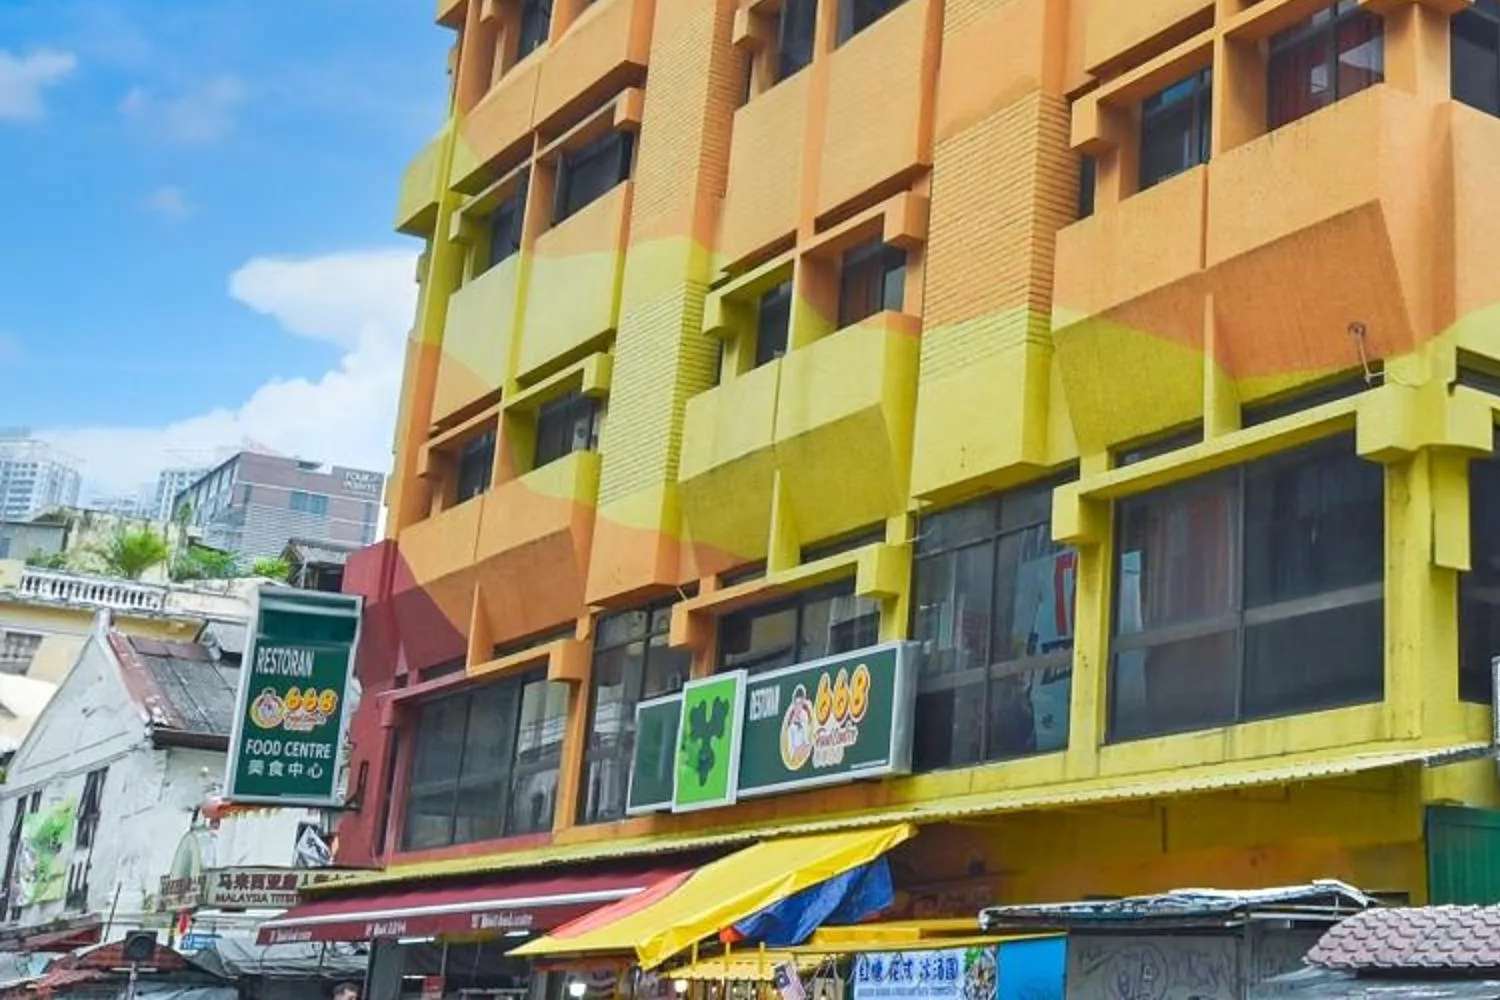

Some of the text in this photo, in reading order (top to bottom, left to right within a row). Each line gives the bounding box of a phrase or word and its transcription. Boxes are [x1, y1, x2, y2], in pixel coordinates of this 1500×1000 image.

[256, 647, 314, 677] RESTORAN
[815, 664, 871, 726] 668
[245, 739, 333, 759] FOOD CENTRE
[248, 759, 323, 778] 美食中心
[215, 893, 268, 904] MALAYSIA
